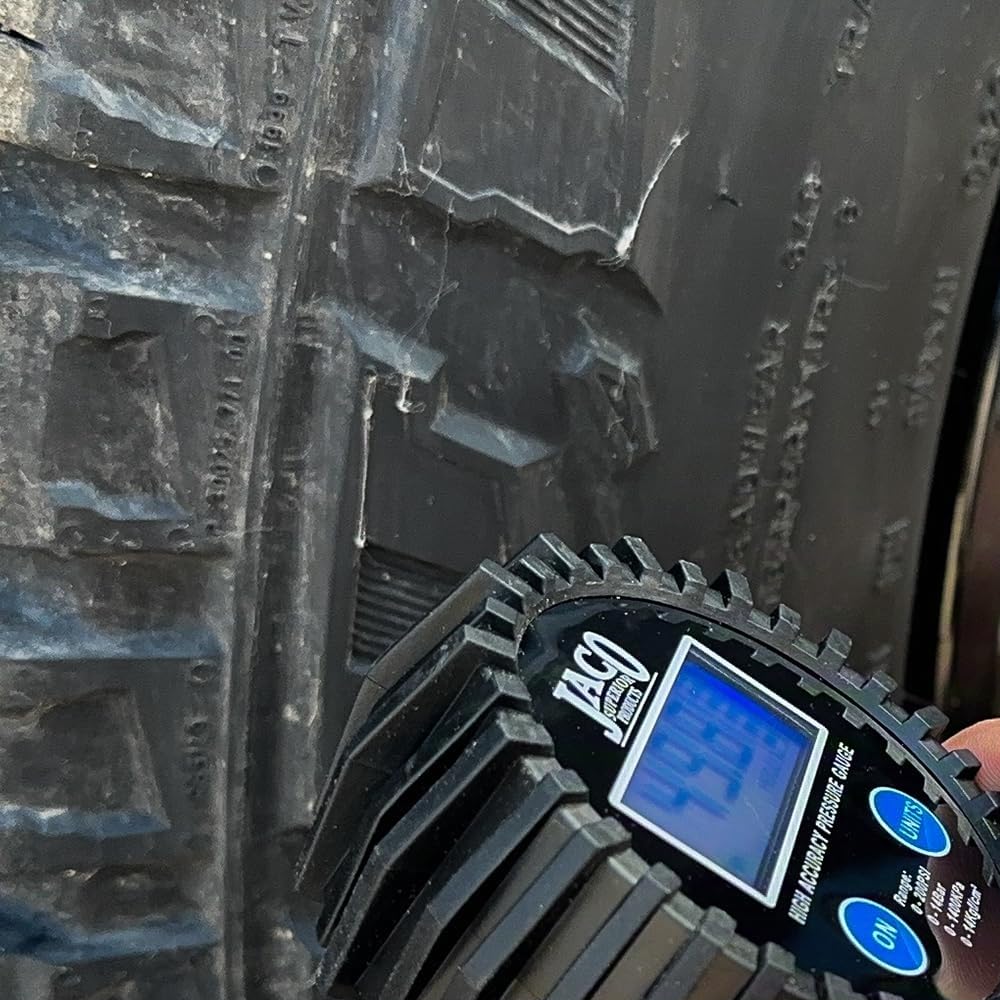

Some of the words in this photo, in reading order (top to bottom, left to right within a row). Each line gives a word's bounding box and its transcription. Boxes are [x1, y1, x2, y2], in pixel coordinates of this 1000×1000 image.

[552, 630, 651, 745] JACO
[603, 673, 636, 723] SUPERIOR
[832, 742, 855, 781] GAUGE
[817, 776, 845, 840] PRESSURE
[901, 800, 925, 841] UNITS
[798, 830, 830, 888] ACCURACY
[788, 888, 812, 925] HIGH
[893, 869, 913, 908] Range:
[872, 917, 900, 951] ON
